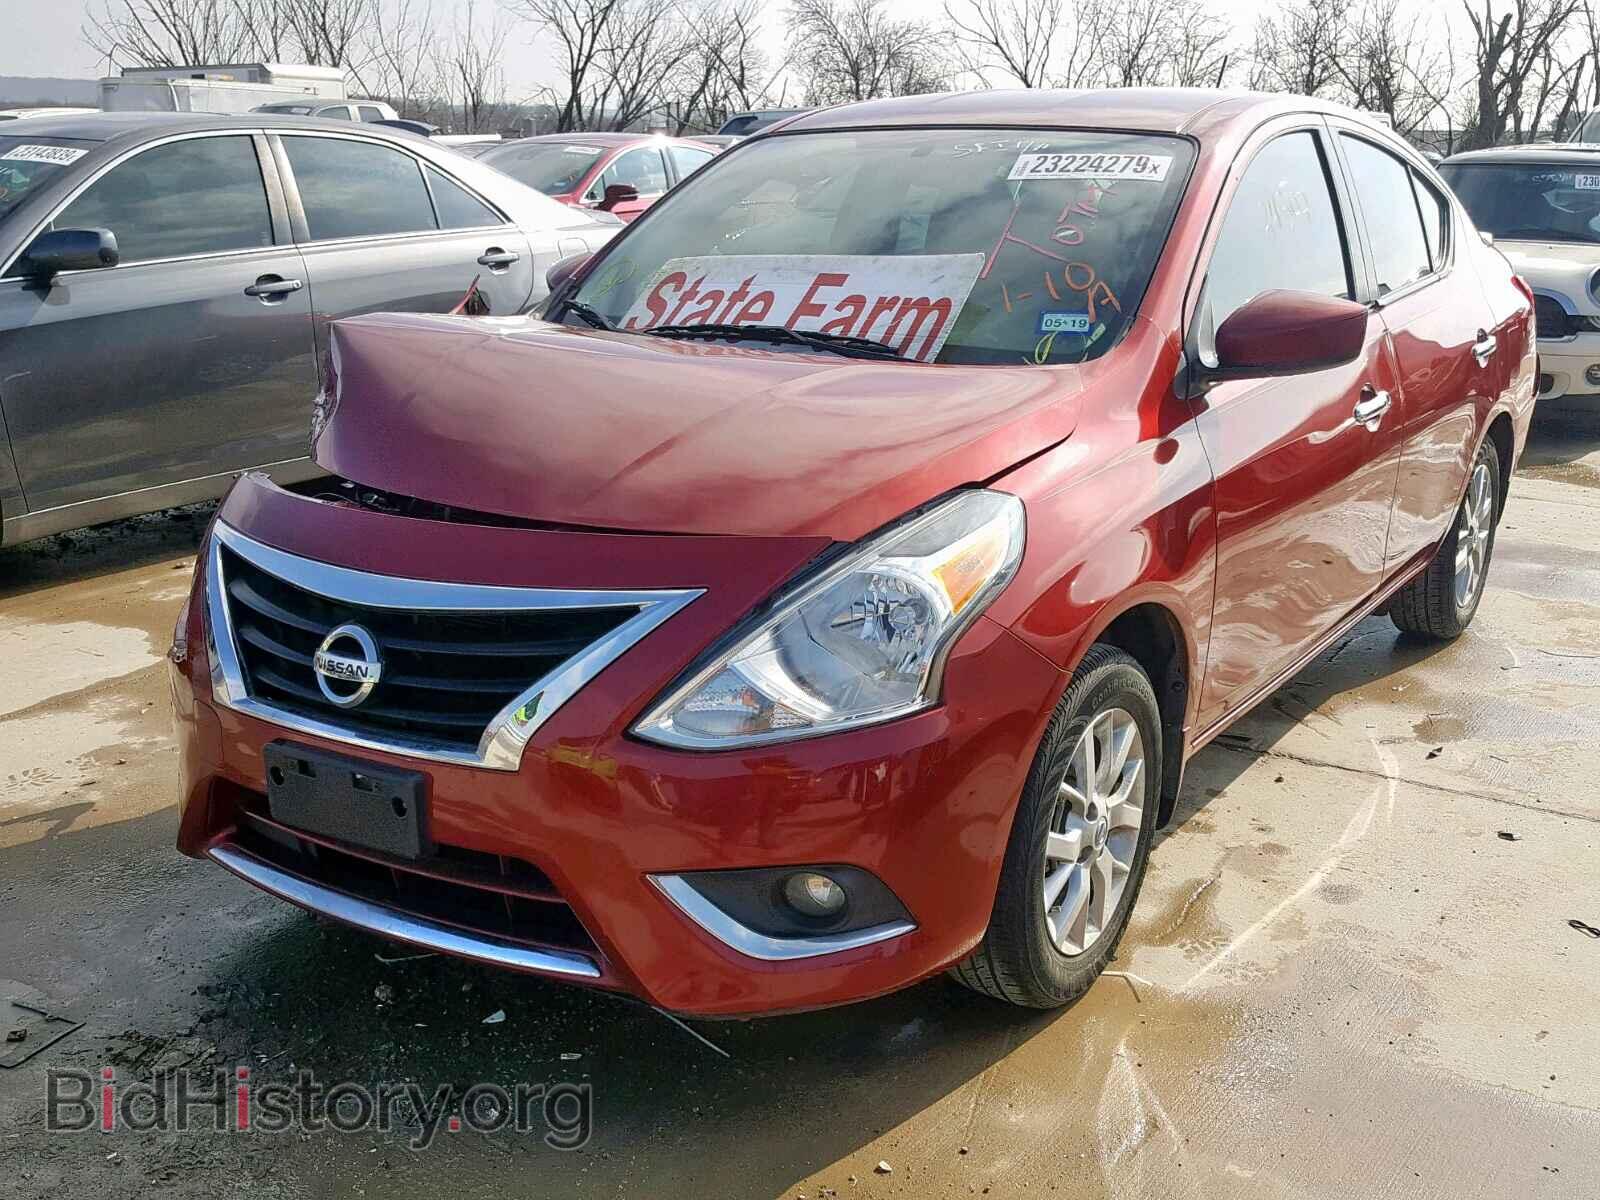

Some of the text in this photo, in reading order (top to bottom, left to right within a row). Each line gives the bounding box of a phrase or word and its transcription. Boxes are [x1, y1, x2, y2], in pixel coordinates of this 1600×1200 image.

[625, 271, 776, 330] State
[786, 272, 952, 361] Farm
[1044, 318, 1088, 329] 05 19
[315, 656, 369, 679] NISSAN
